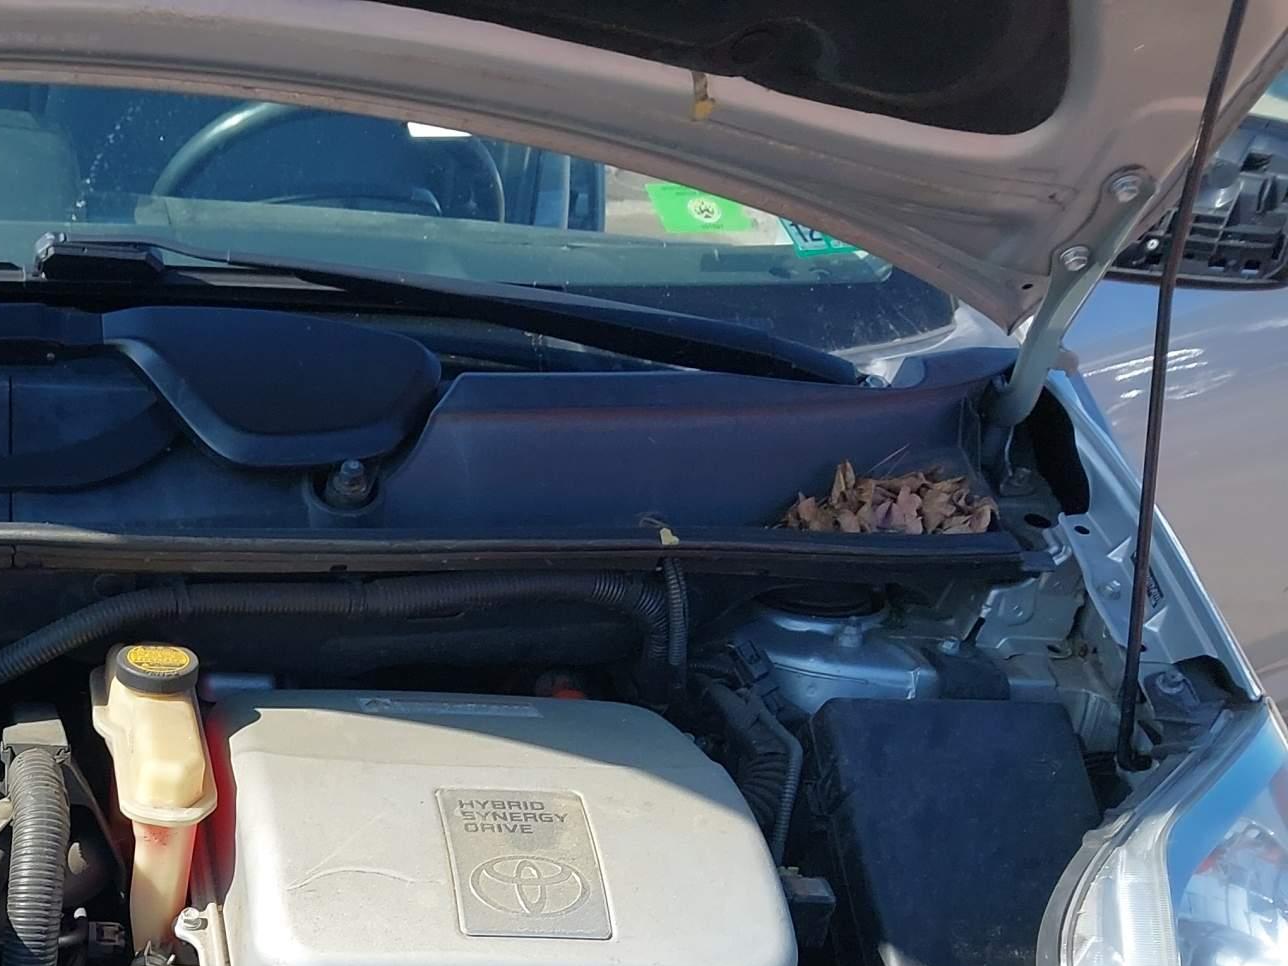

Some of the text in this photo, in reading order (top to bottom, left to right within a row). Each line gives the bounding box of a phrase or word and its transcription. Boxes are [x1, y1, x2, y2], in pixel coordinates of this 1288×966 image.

[458, 799, 545, 811] HYBRID
[461, 811, 568, 823] SYNERGY
[464, 822, 534, 834] DRIVE
